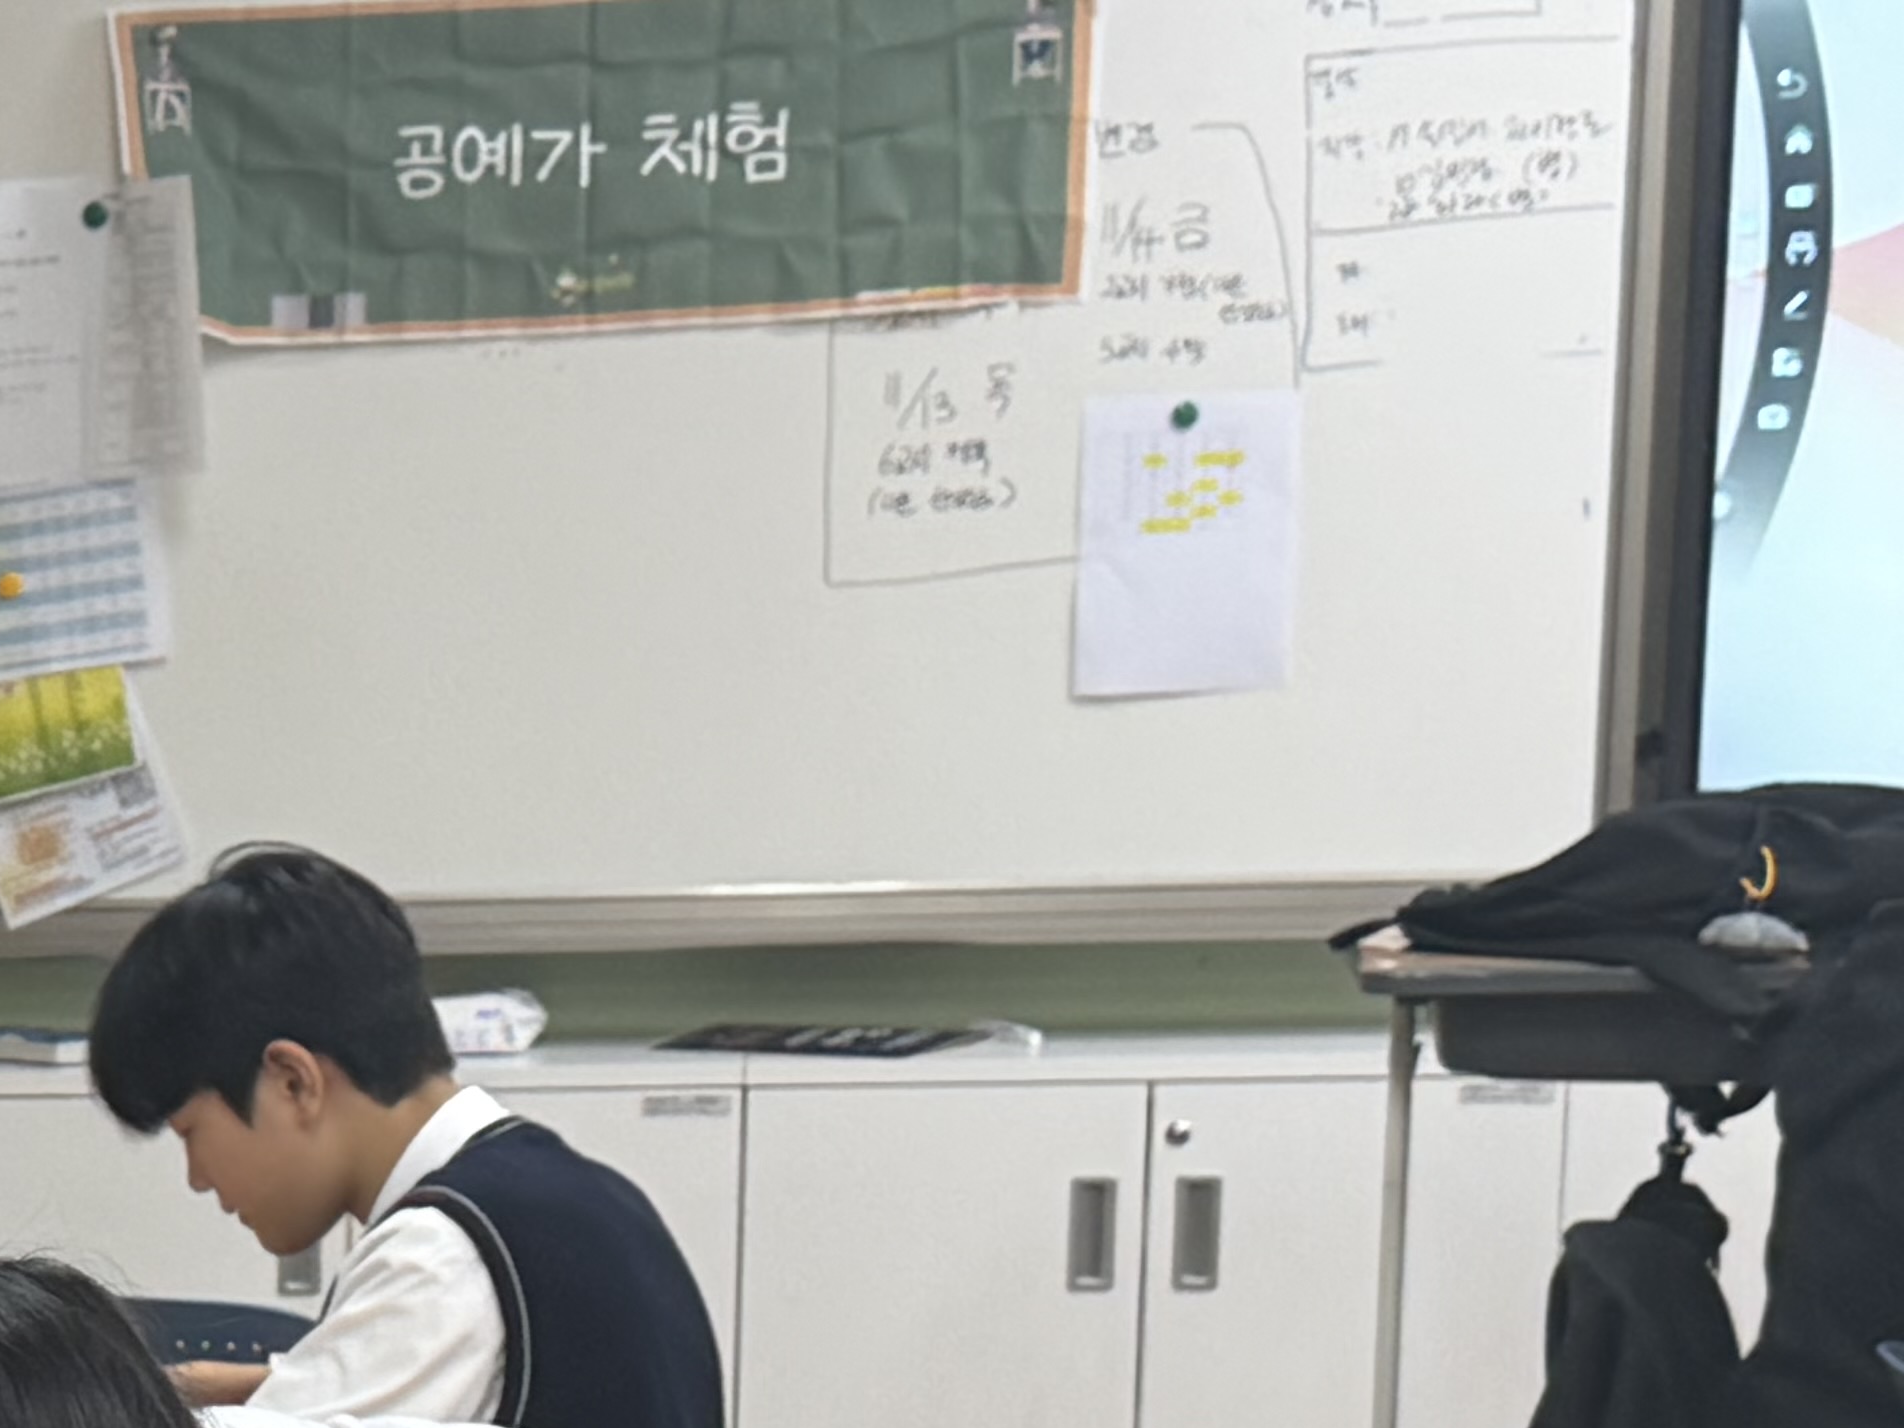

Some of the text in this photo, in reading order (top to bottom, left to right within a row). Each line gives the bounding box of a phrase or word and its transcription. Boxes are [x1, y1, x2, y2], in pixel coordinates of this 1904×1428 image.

[394, 100, 789, 200] 공예가 체험
[1170, 202, 1211, 253] 금
